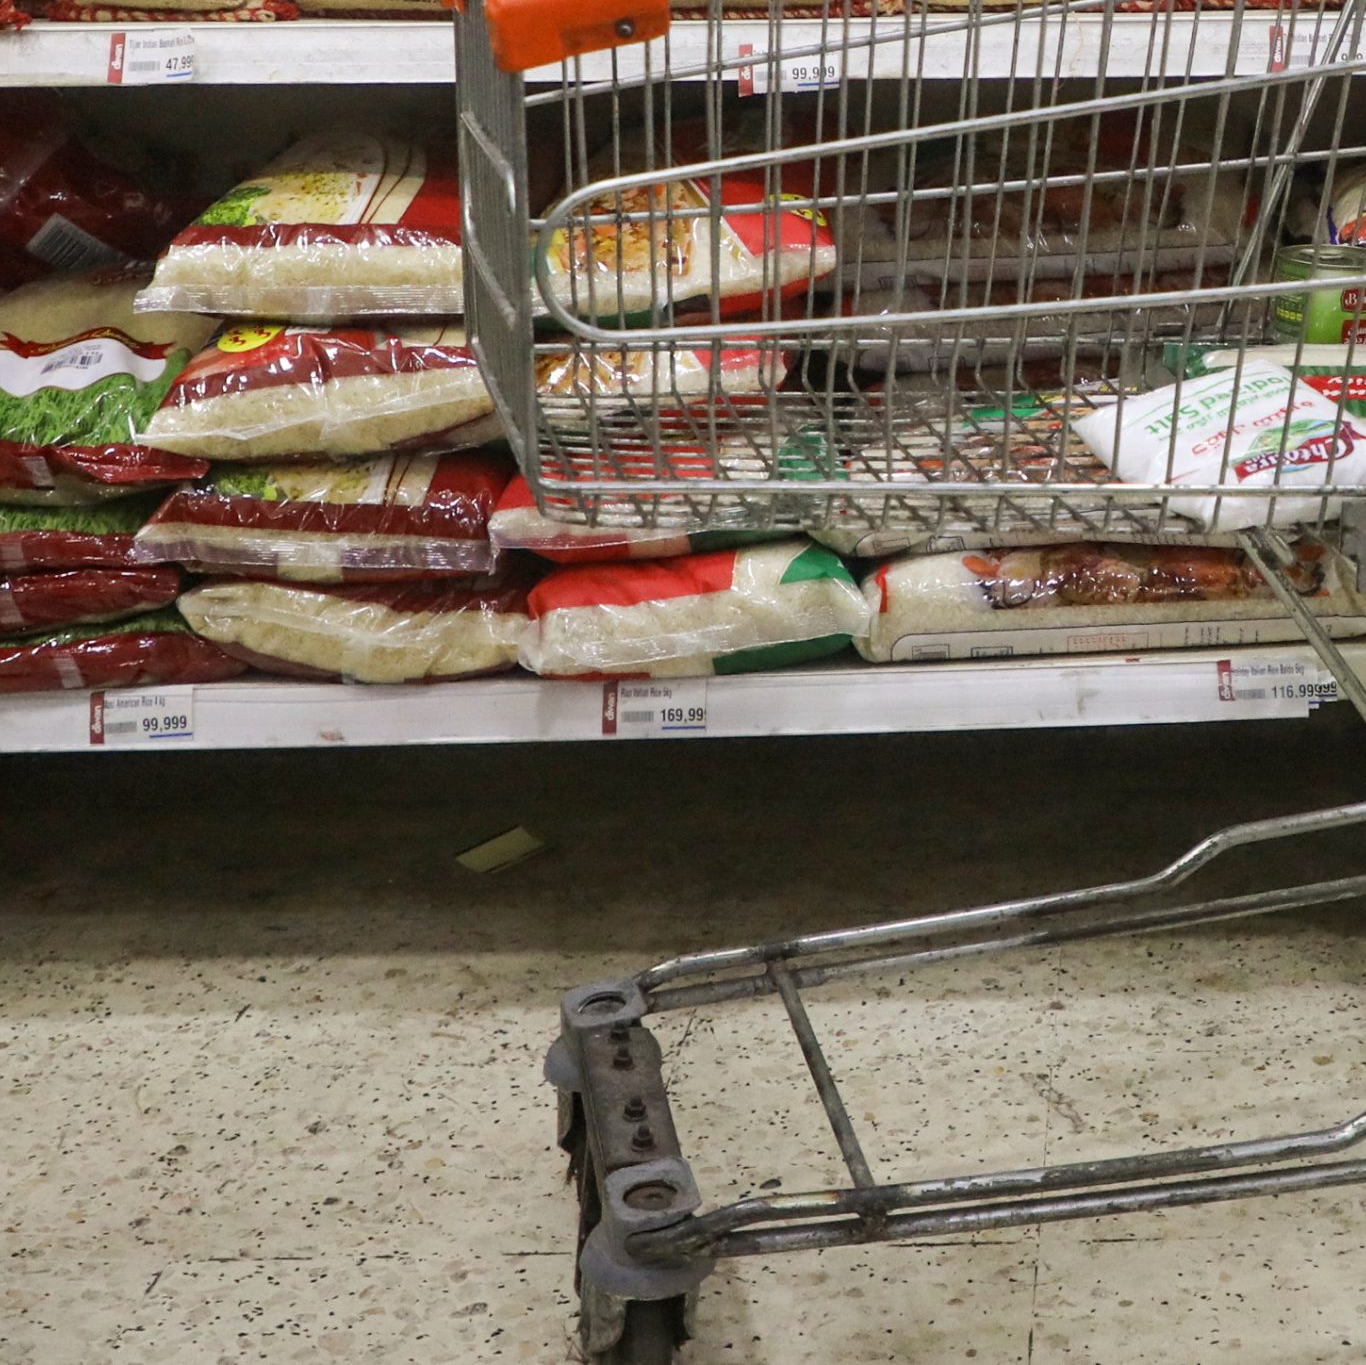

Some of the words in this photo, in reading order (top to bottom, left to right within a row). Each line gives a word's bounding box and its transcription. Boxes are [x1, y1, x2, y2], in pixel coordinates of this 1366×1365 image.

[1143, 403, 1201, 436] Salt
[142, 715, 188, 733] 99,999
[660, 707, 706, 724] 169,99
